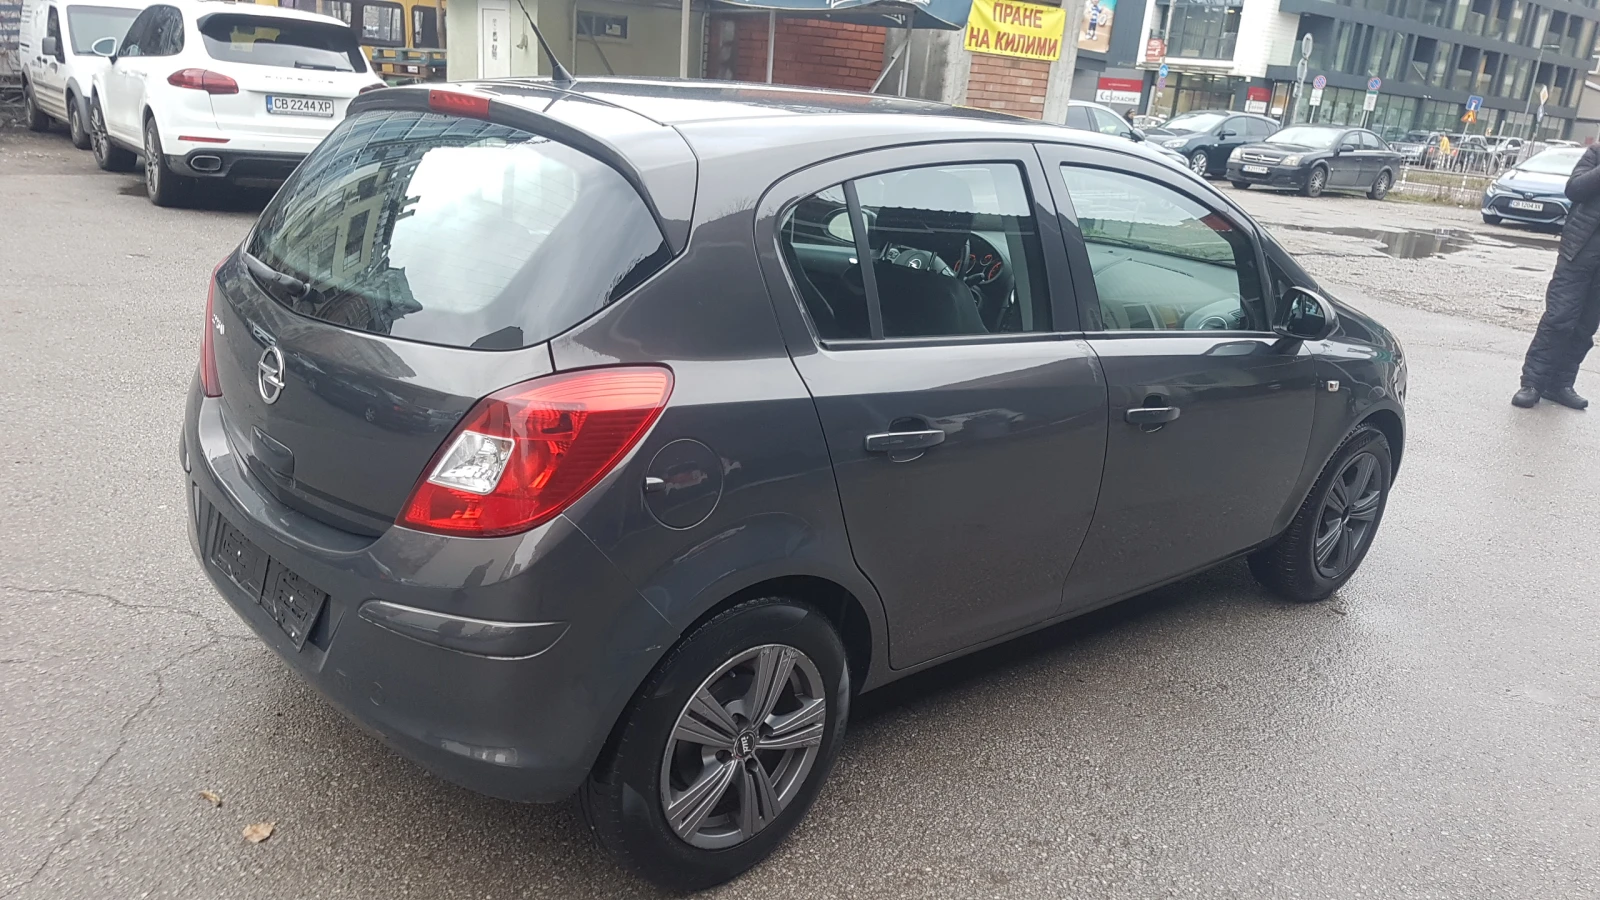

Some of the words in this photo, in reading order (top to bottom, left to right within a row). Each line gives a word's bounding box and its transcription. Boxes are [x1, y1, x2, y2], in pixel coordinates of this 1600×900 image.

[993, 2, 1043, 29] ПРАНЕ
[969, 26, 990, 49] НА
[994, 31, 1058, 57] КИЛИМИ
[290, 99, 316, 111] 2244
